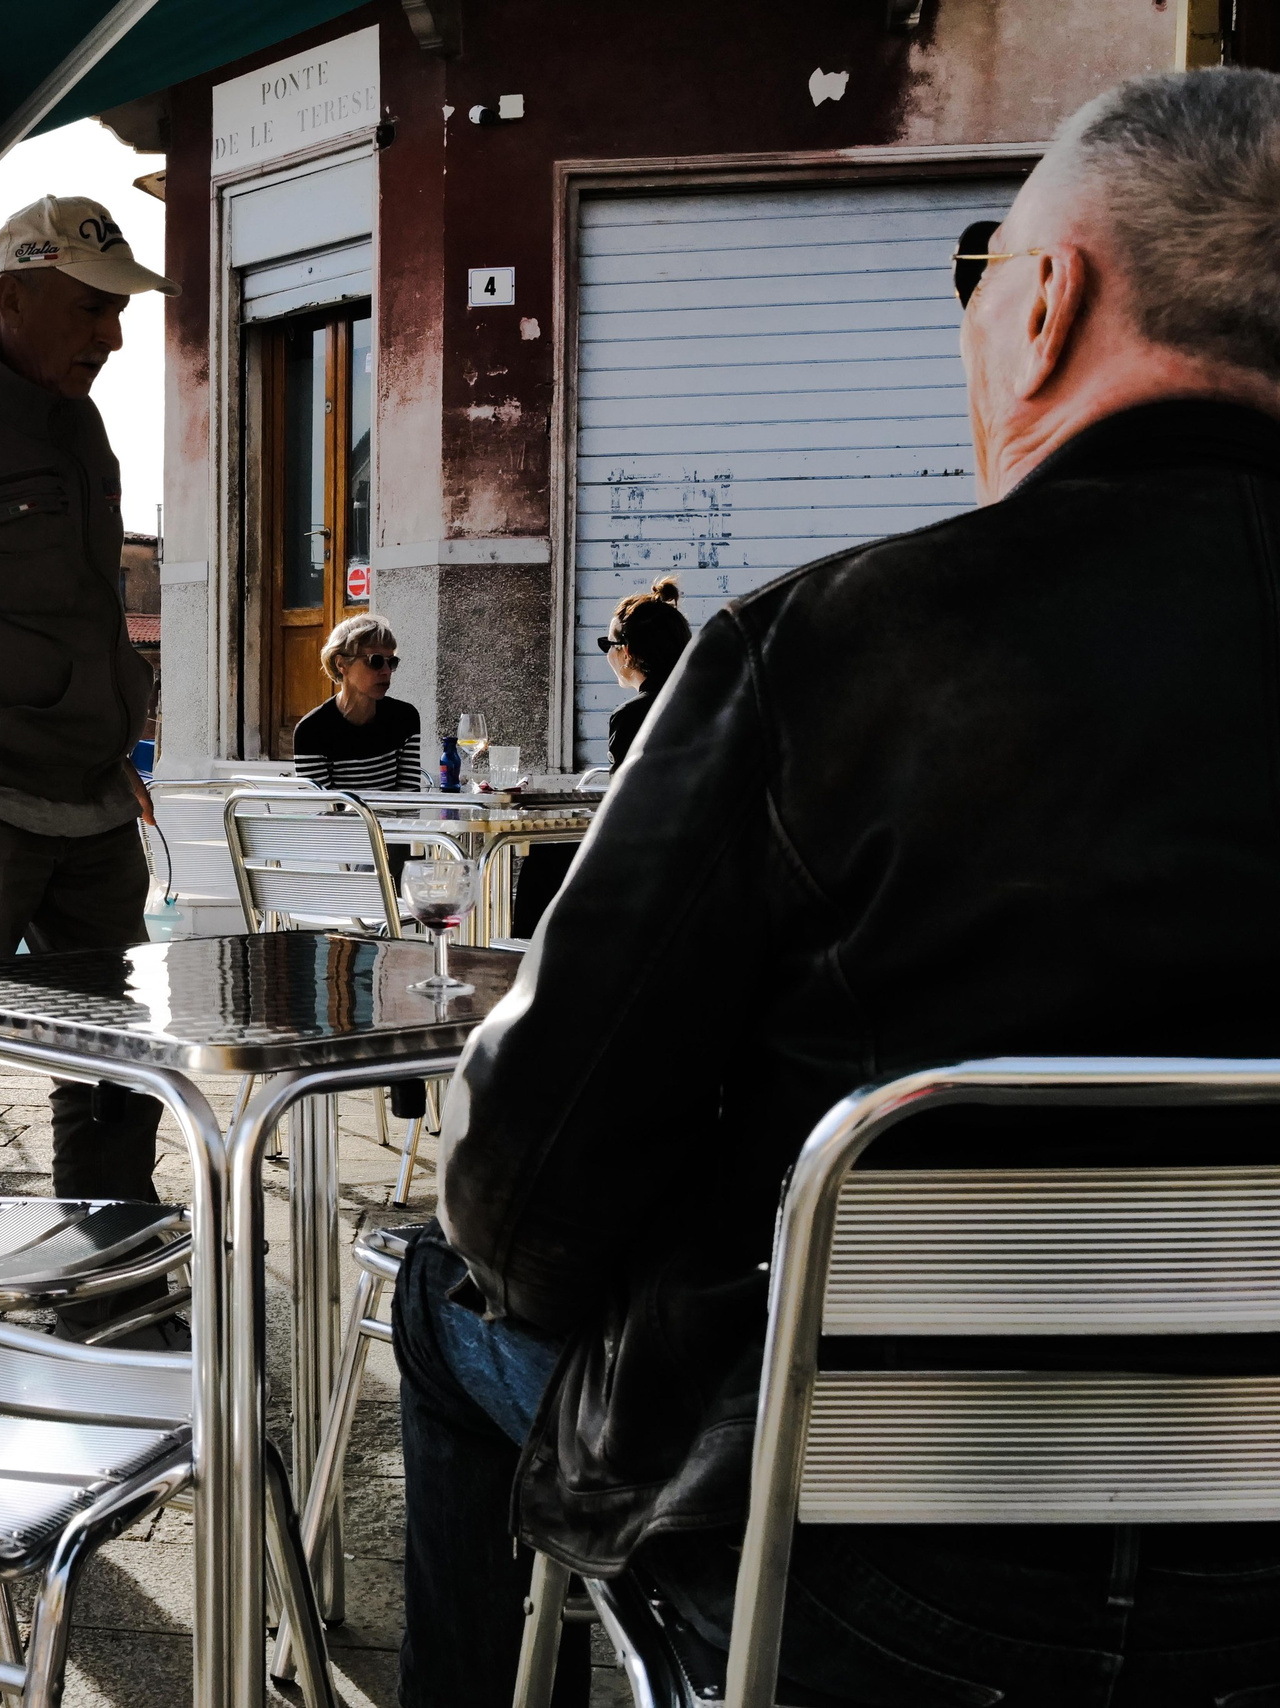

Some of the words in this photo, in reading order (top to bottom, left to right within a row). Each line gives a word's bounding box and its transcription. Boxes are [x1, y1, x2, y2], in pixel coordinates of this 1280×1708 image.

[261, 60, 329, 105] PONTE
[215, 132, 239, 160] DE
[251, 120, 274, 148] LE
[297, 86, 376, 133] TERESE
[15, 240, 60, 257] Italia
[484, 276, 496, 296] 4
